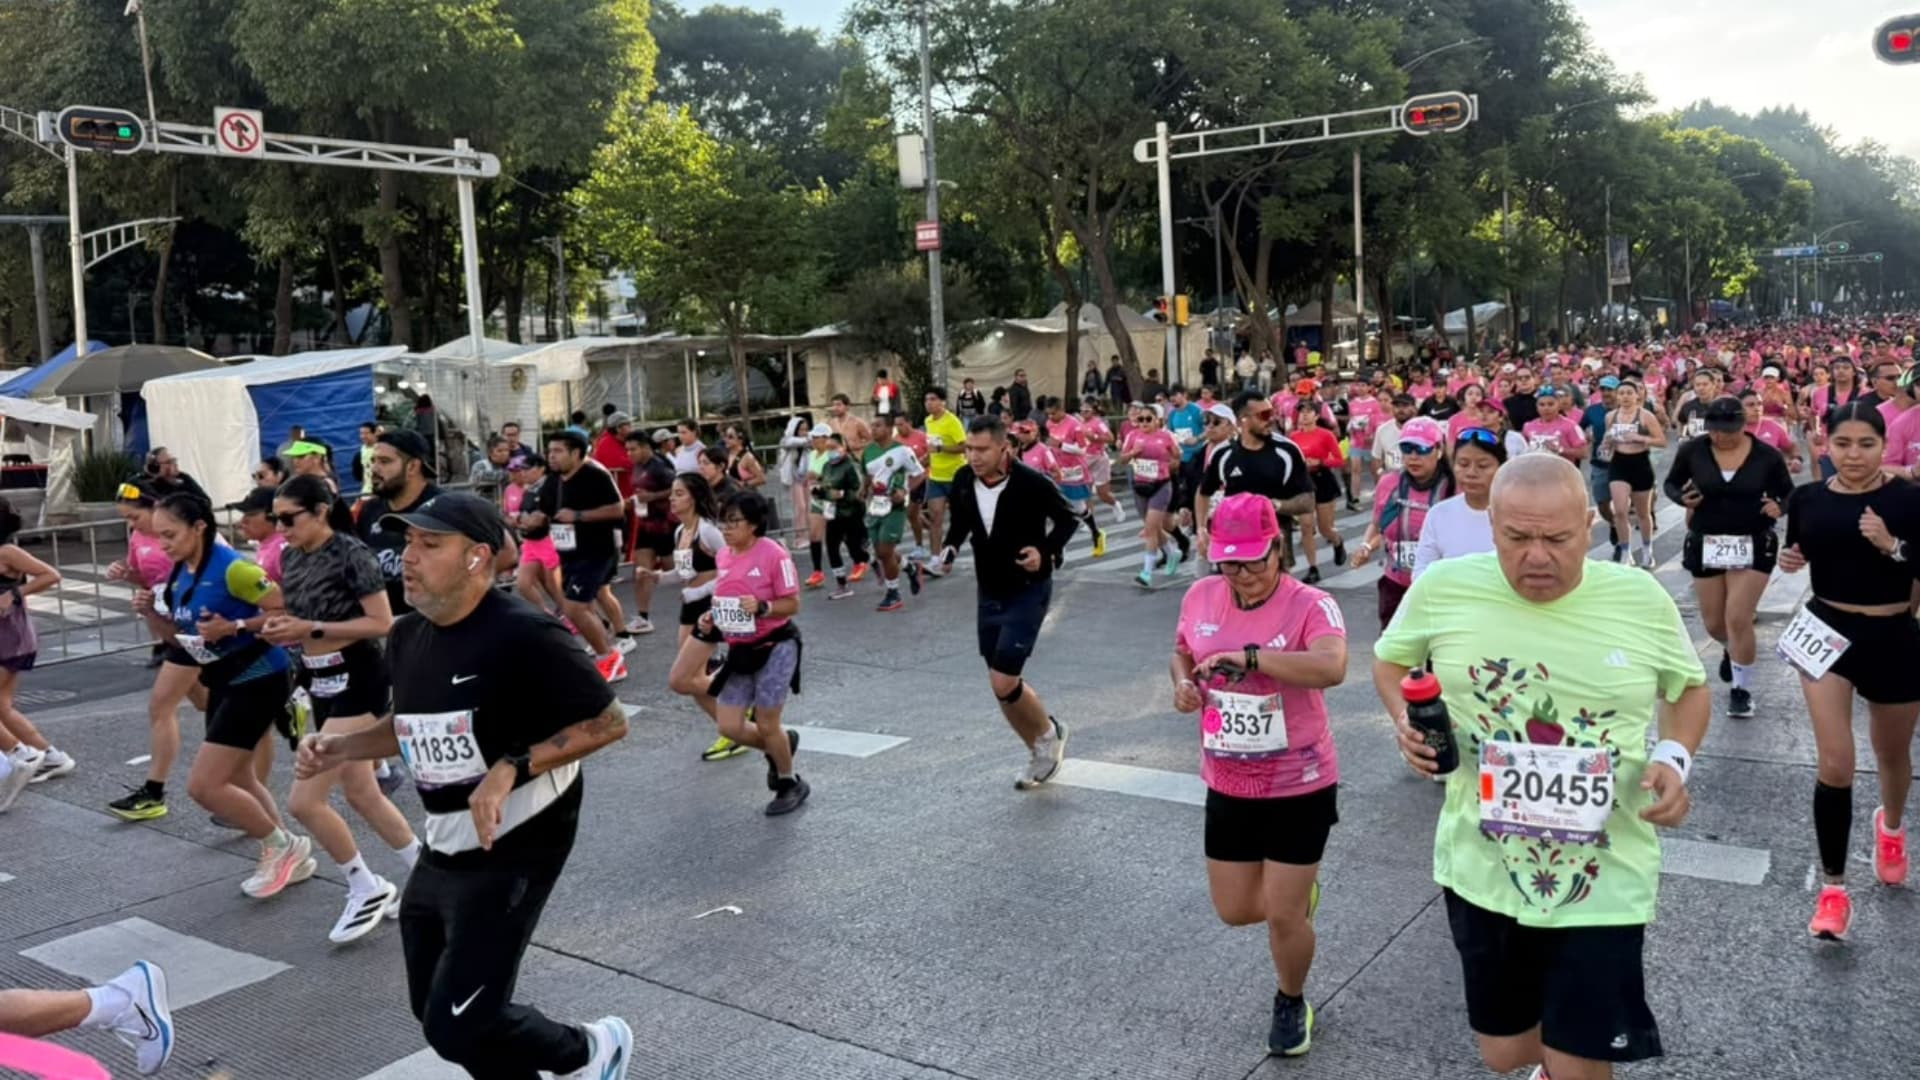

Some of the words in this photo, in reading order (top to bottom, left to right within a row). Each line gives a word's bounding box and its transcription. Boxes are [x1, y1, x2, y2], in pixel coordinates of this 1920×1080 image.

[1715, 543, 1748, 557] 2719
[717, 608, 752, 623] 17089
[1221, 710, 1273, 736] 3537
[410, 734, 475, 764] 11833
[1502, 768, 1609, 807] 20455
